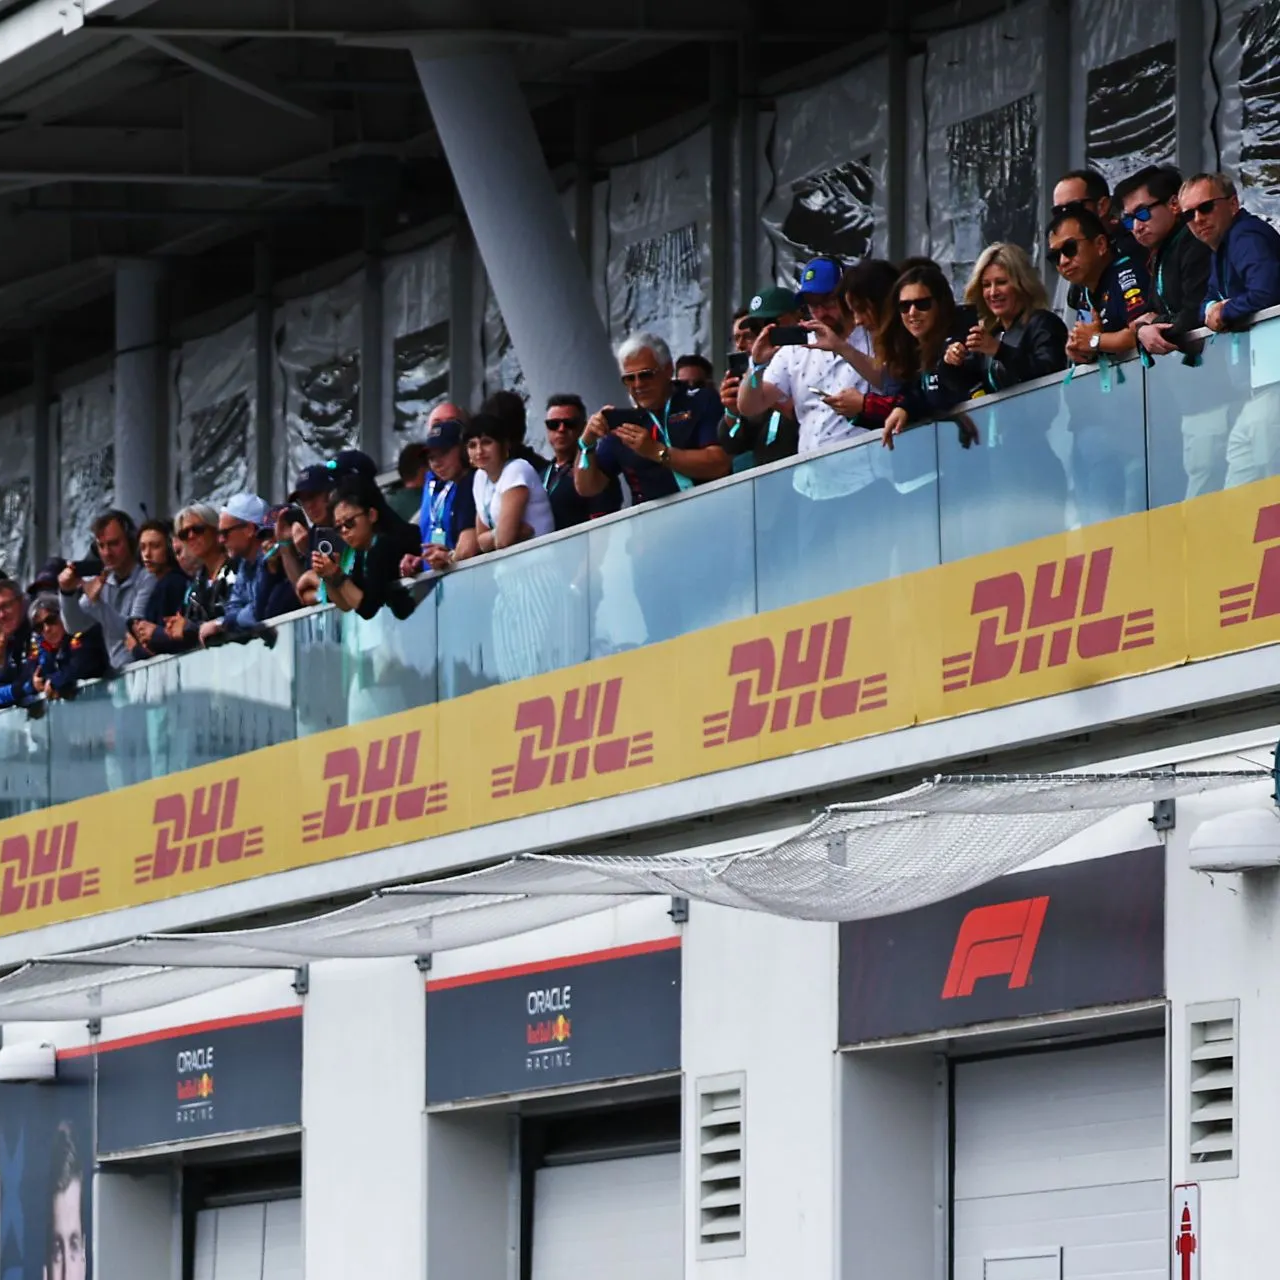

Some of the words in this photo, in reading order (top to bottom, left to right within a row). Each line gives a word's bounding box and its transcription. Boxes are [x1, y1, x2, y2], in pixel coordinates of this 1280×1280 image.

[970, 547, 1125, 686] DHL
[727, 616, 862, 745] DHL
[321, 731, 429, 839] DHL
[512, 677, 630, 795] DHL
[0, 821, 85, 916] DHL
[151, 777, 246, 881] DHL
[527, 985, 571, 1015] ORACLE
[177, 1046, 214, 1073] ORACLE
[526, 1052, 572, 1071] RACING
